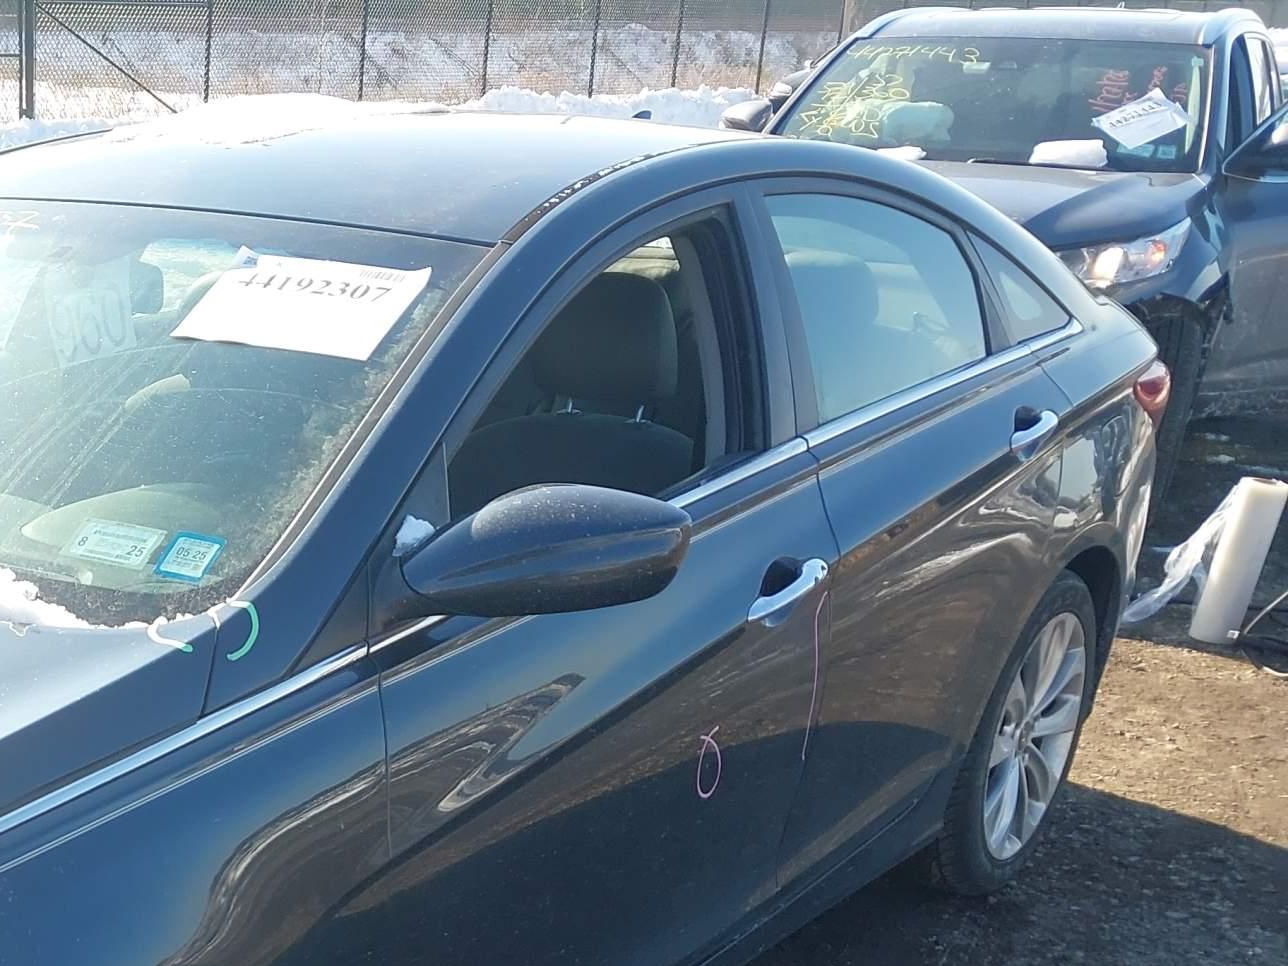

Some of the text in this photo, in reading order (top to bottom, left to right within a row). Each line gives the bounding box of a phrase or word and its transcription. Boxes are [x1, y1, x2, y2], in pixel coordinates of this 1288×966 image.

[237, 272, 393, 302] 44192307
[78, 536, 89, 547] 8
[125, 544, 146, 558] 25
[192, 550, 208, 560] 25
